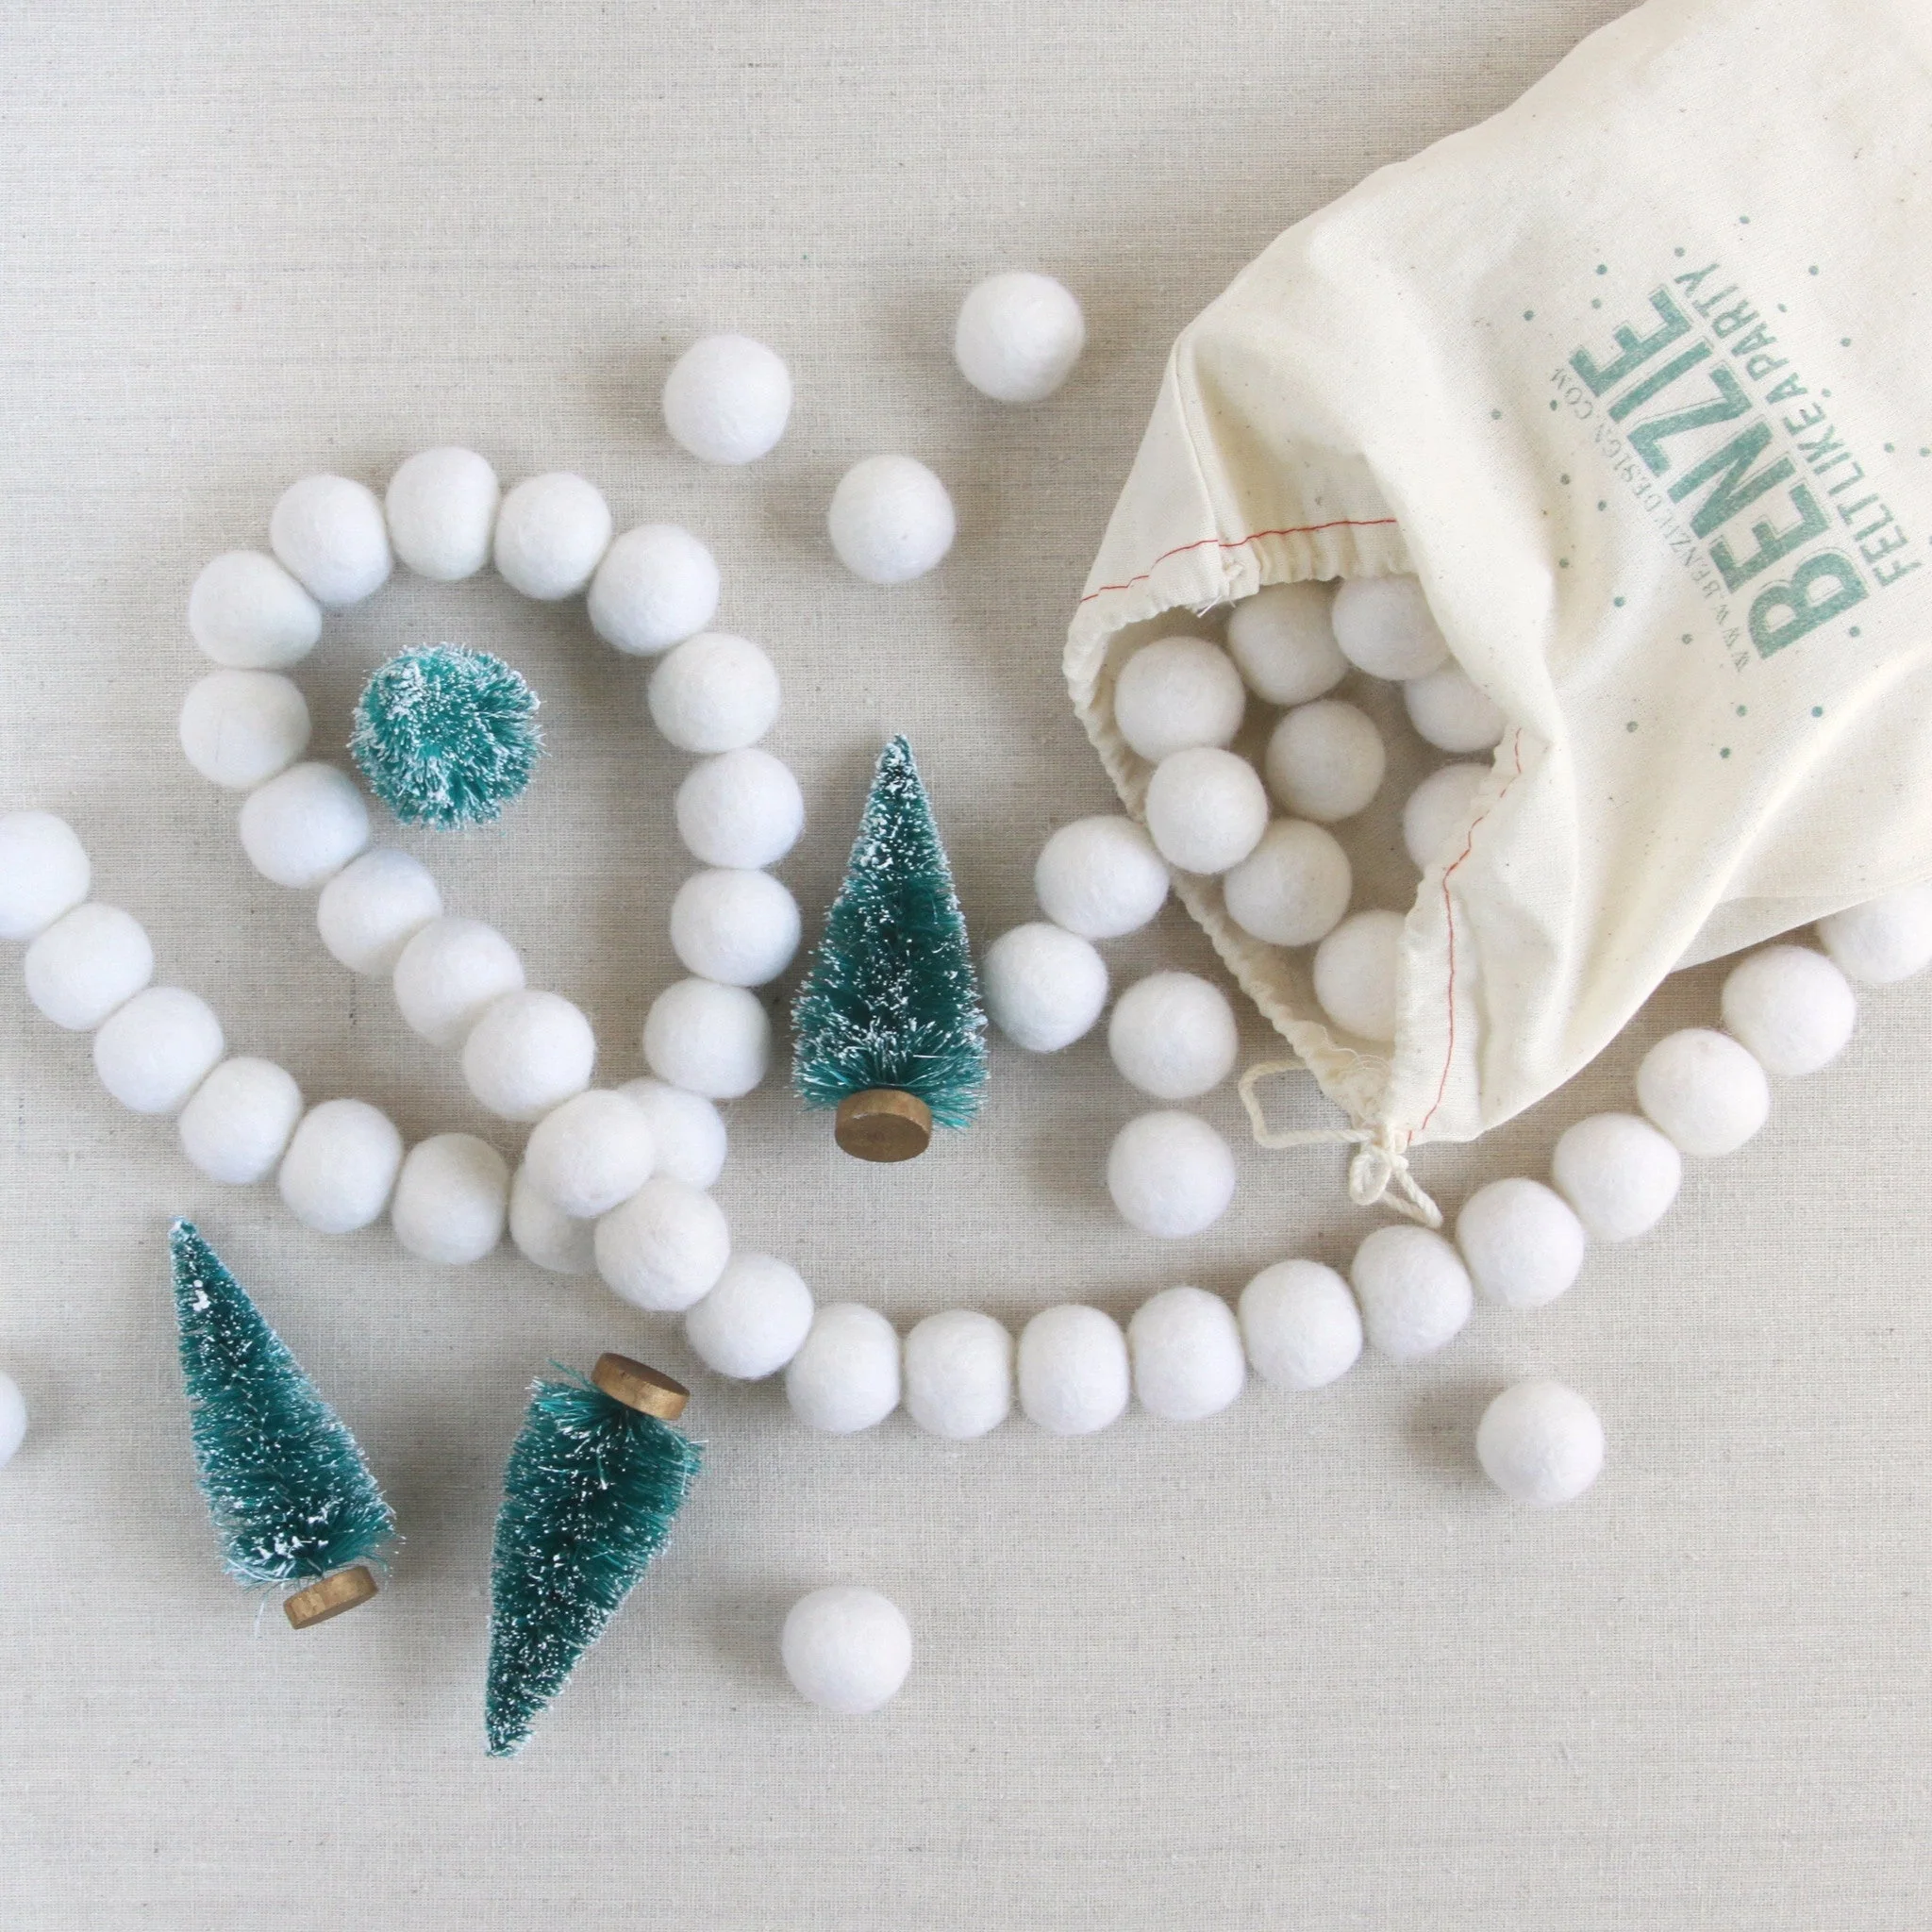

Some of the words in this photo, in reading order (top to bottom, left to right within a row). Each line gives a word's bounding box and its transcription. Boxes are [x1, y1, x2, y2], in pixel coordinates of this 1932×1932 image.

[1674, 261, 1790, 382] PARTY
[1764, 371, 1808, 406] A
[1568, 282, 1871, 661] BENZIE
[1781, 401, 1866, 498] LIKE
[1836, 492, 1924, 588] FELT
